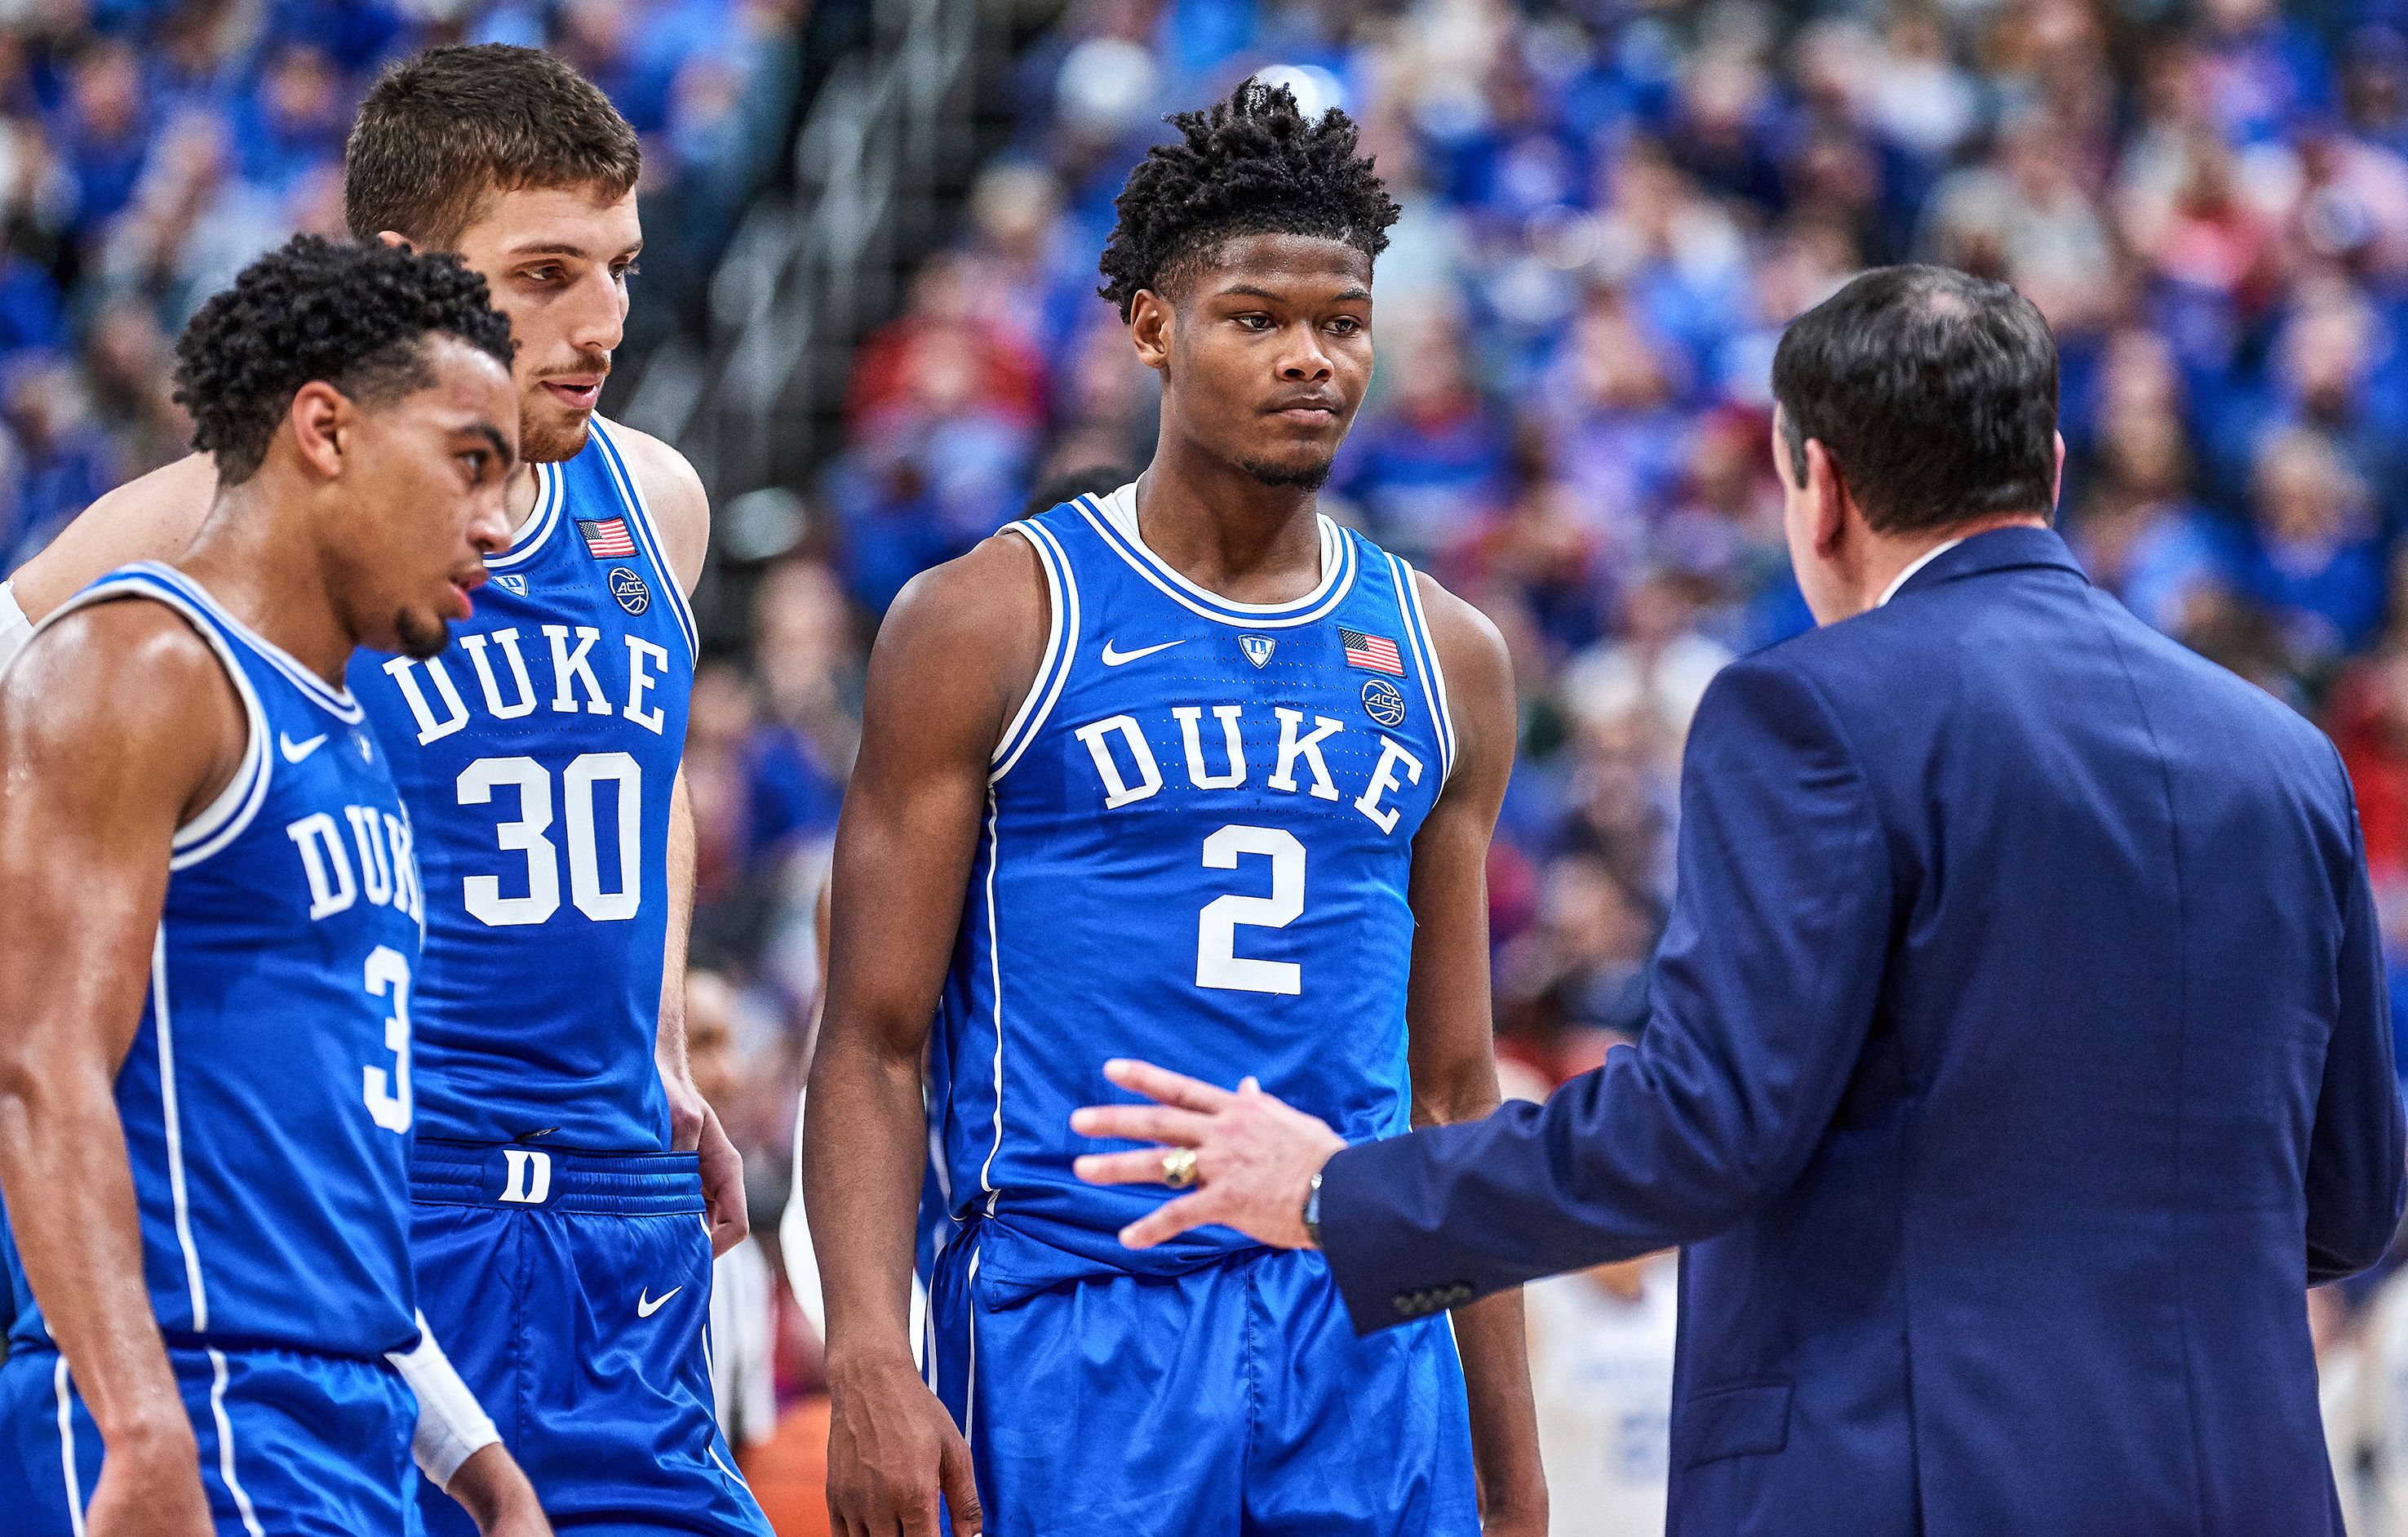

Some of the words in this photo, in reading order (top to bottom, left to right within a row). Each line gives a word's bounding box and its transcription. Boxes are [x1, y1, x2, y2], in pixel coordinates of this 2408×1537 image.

[618, 580, 644, 593] ACC
[382, 624, 668, 746] DUKE
[1368, 693, 1402, 708] ACC
[1074, 704, 1424, 836] DUKE
[286, 804, 422, 925] DUK
[456, 752, 642, 926] 30
[1195, 824, 1307, 996] 2
[363, 944, 410, 1135] 3
[498, 1149, 551, 1204] D
